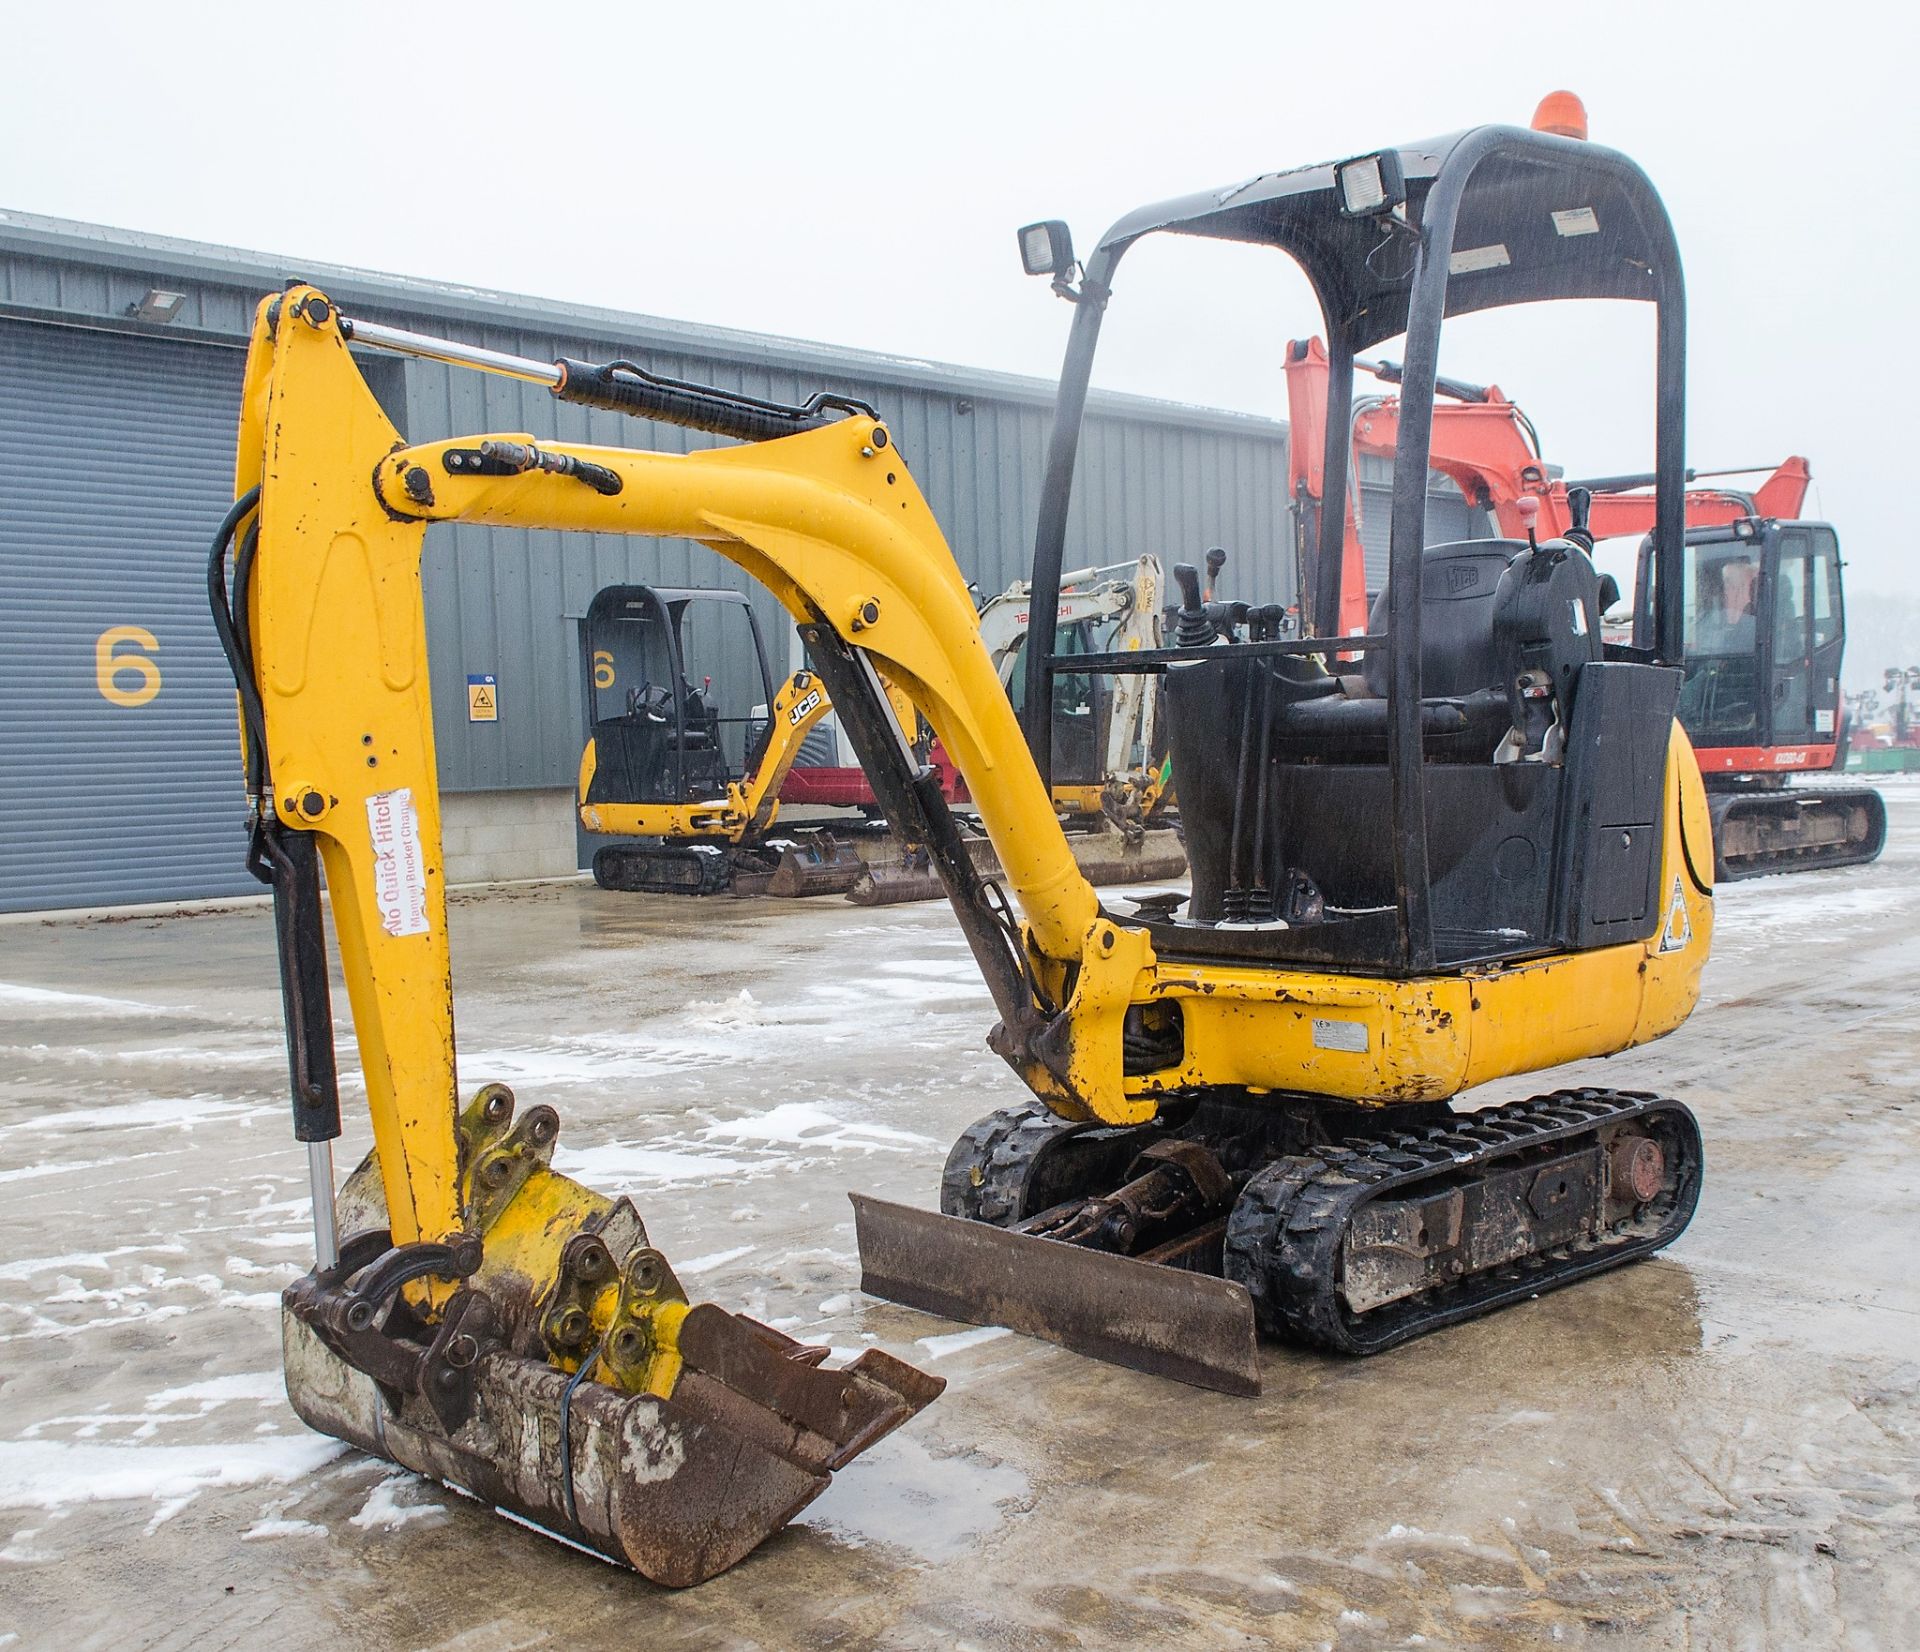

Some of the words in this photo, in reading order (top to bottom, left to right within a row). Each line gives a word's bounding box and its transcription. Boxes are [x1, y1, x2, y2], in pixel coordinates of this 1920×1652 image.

[96, 625, 162, 707] 6
[593, 650, 616, 689] 6
[789, 689, 821, 725] JCB
[373, 793, 393, 844] Hitch
[379, 848, 400, 903] Quick
[402, 840, 416, 882] Bucket
[386, 908, 403, 933] No
[407, 884, 421, 928] Manual
